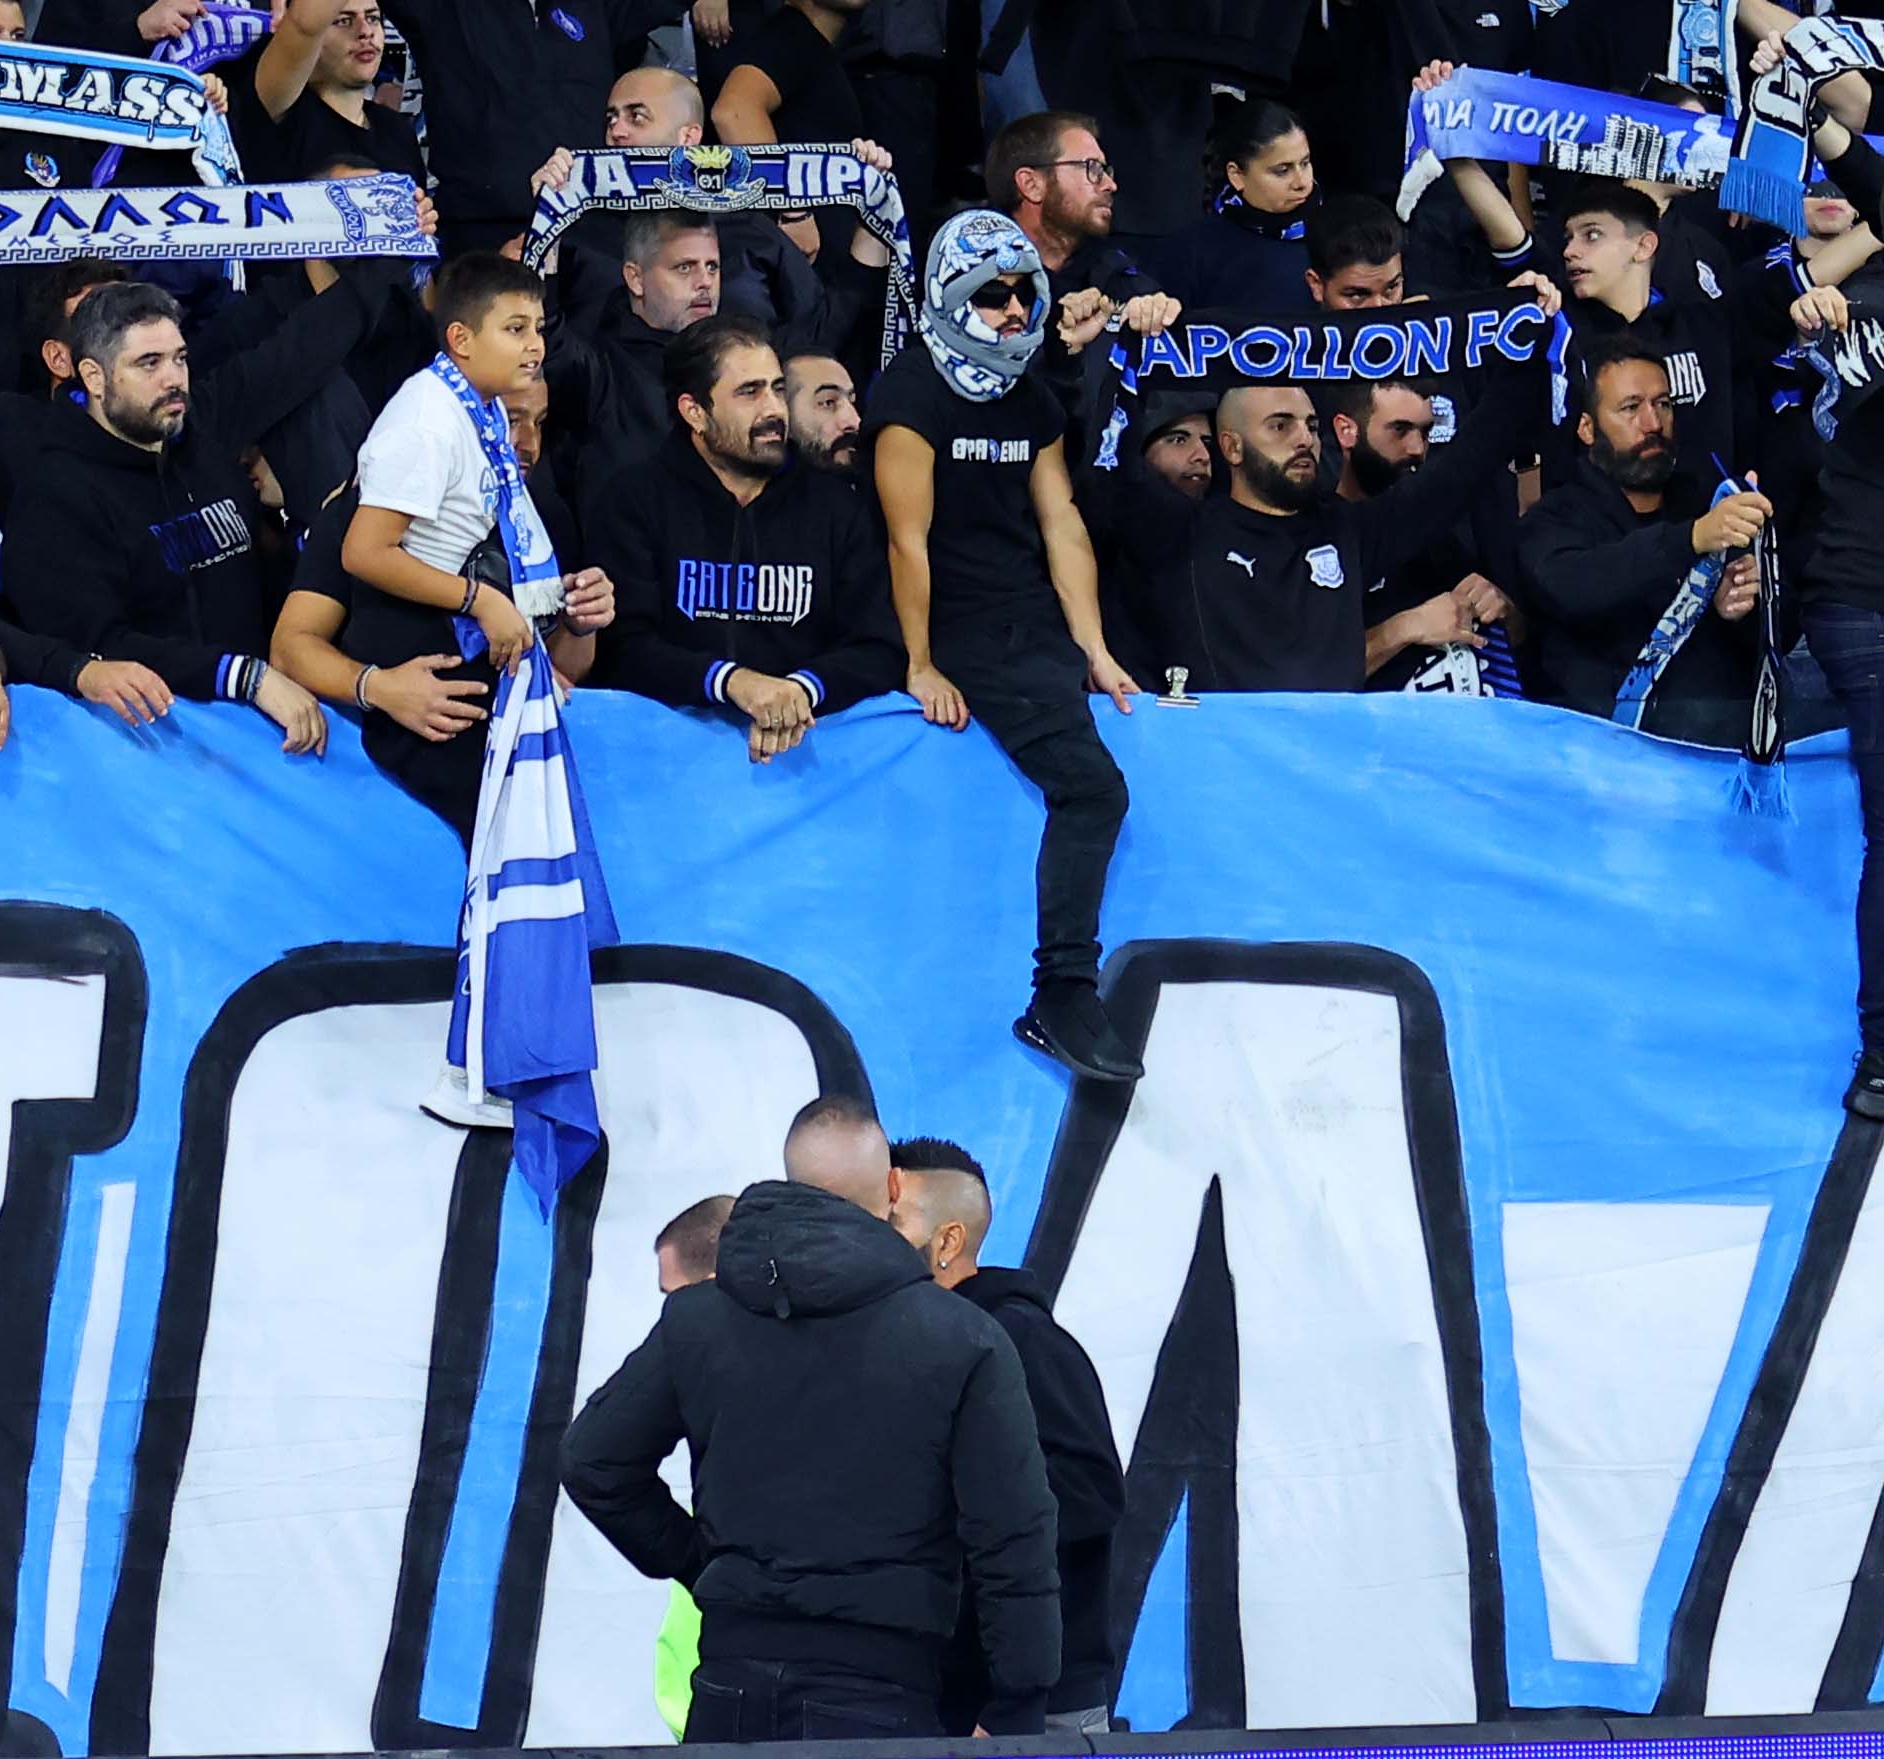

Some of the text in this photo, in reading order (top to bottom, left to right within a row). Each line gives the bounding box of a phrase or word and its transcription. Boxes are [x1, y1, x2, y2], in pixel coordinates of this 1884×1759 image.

[1489, 99, 1590, 142] ΠΟΛΗ
[1137, 300, 1548, 381] APOLLON FC
[675, 558, 815, 629] GATEONE
